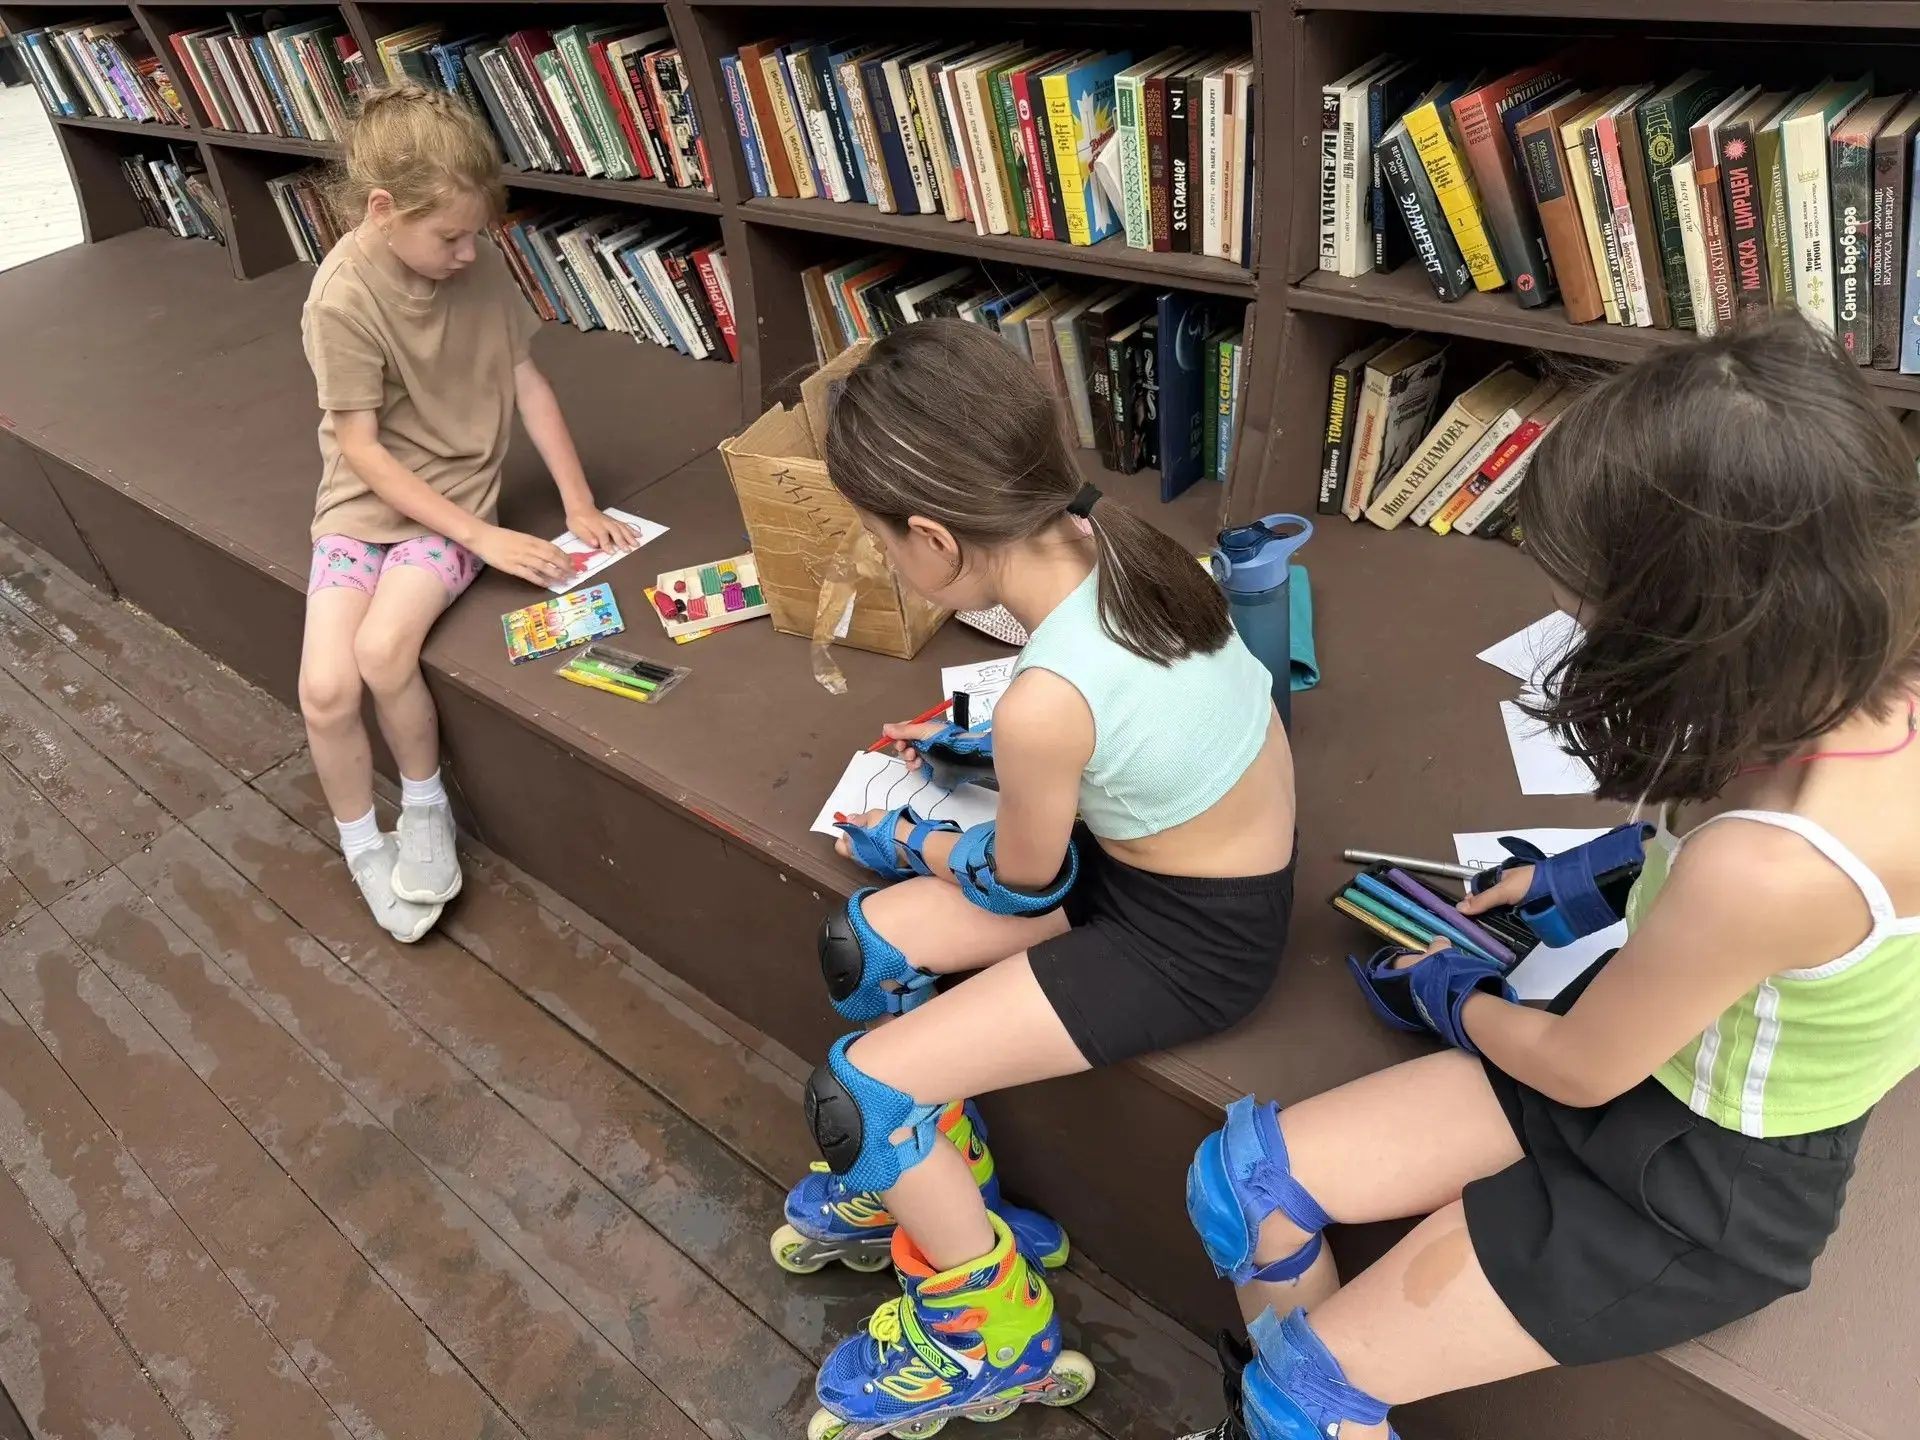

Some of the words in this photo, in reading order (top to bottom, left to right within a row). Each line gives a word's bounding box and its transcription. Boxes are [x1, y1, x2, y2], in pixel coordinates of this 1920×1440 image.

[900, 115, 914, 157] ЗЕМЛИ
[912, 165, 922, 188] ЗОВ
[924, 159, 933, 176] ЛЕРУ
[1067, 179, 1072, 188] 3
[1322, 134, 1337, 220] МАКБЕЙН
[1342, 162, 1354, 180] ДЕНЬ
[1388, 160, 1399, 176] РОТ
[1391, 145, 1409, 186] ВЕРОНИКА
[1772, 163, 1784, 198] БУМАГЕ
[929, 175, 940, 200] ГАСТОН
[1729, 166, 1757, 232] ЦИРЦЕИ
[1873, 187, 1883, 230] ЖИЛИЩЕ
[1884, 186, 1895, 233] ВЕНЕЦИИ
[1322, 232, 1337, 256] ЭД
[1603, 222, 1620, 275] ХАЙНЛАЙН
[1805, 248, 1813, 273] Морис
[1840, 206, 1858, 274] Барбара
[1873, 232, 1883, 286] ПОДВОДНОЕ
[1630, 270, 1639, 294] ШКОЛА
[1709, 239, 1732, 321] ШКАФЫ-КУПЕ
[1737, 237, 1761, 291] МАСКА
[1782, 257, 1793, 293] ПИСЬМА
[1883, 243, 1894, 286] БЕАТРИСА
[682, 292, 704, 327] киллера
[699, 262, 730, 316] КАРНЕГИ
[1615, 276, 1627, 310] РОБЕРТ
[1840, 277, 1857, 322] Санта
[700, 325, 716, 351] Месть
[1219, 401, 1231, 416] М.
[1327, 374, 1348, 444] ТЕРМИНАТОР
[1380, 485, 1413, 519] Инна
[1407, 417, 1470, 491] ВАРЛАМОВА
